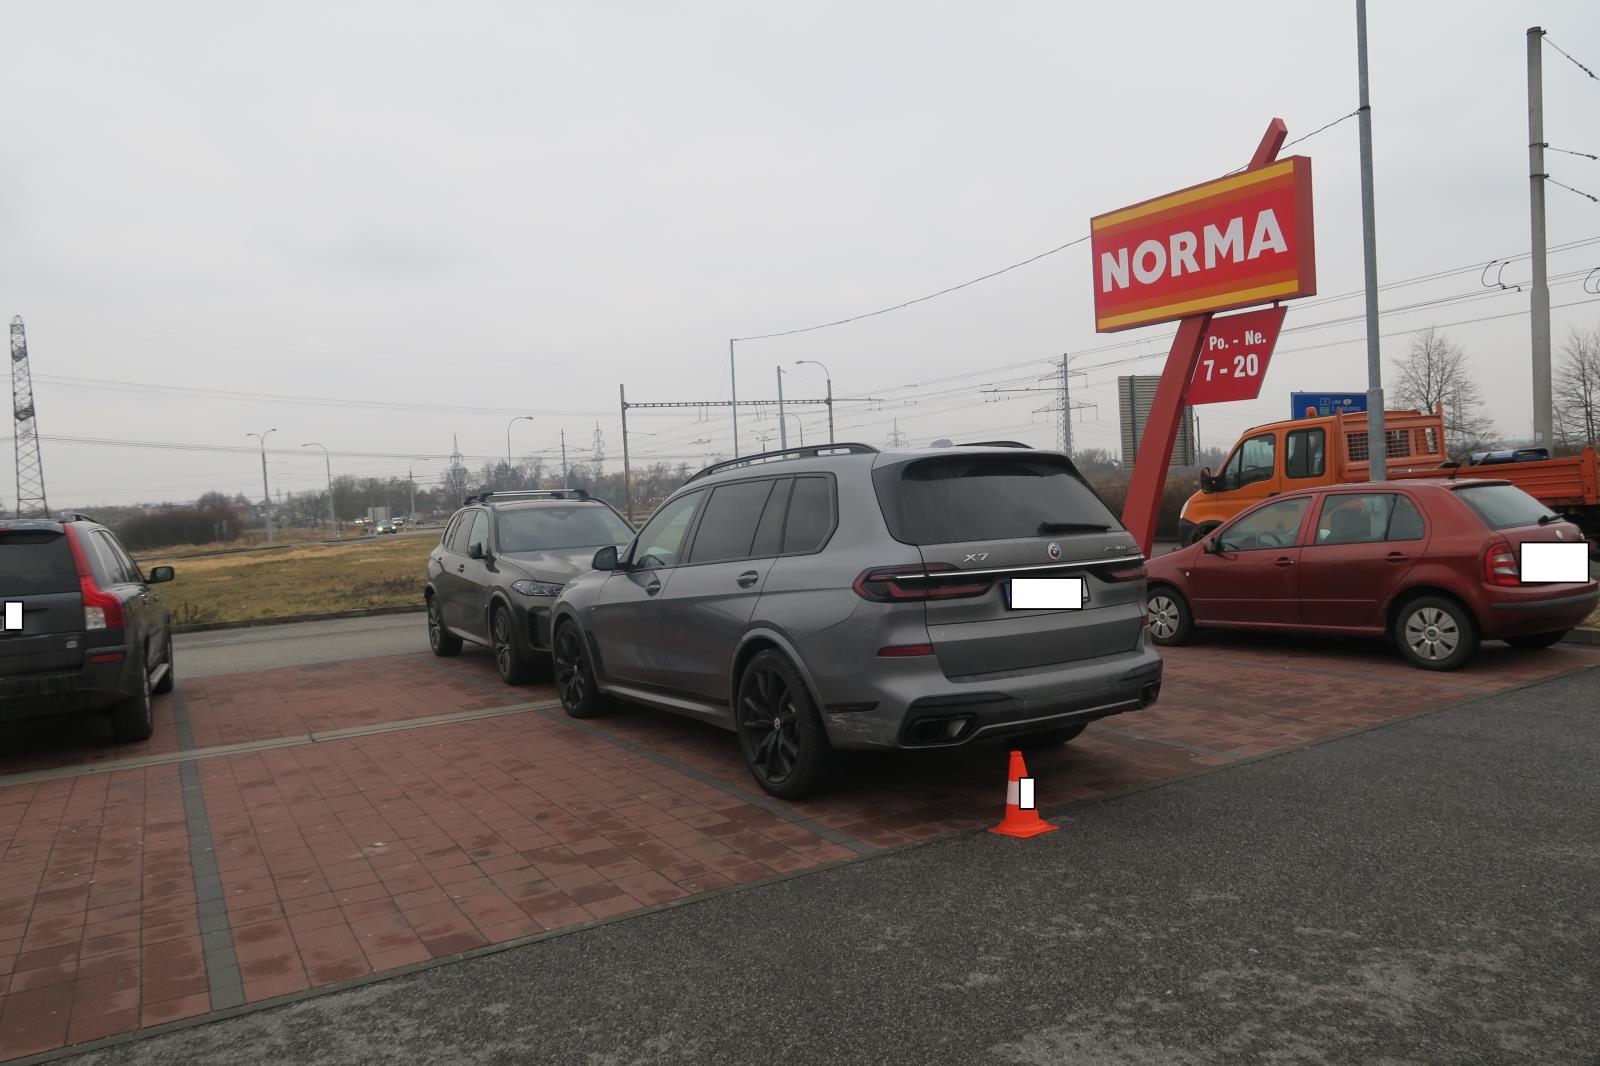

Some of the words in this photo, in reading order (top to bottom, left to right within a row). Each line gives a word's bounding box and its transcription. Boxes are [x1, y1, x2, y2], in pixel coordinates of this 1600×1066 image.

[1101, 208, 1288, 293] NORMA
[1209, 335, 1229, 351] Po.
[1245, 329, 1267, 346] Ne.
[1203, 359, 1215, 382] 7
[1233, 353, 1259, 378] 20
[963, 552, 989, 563] X7
